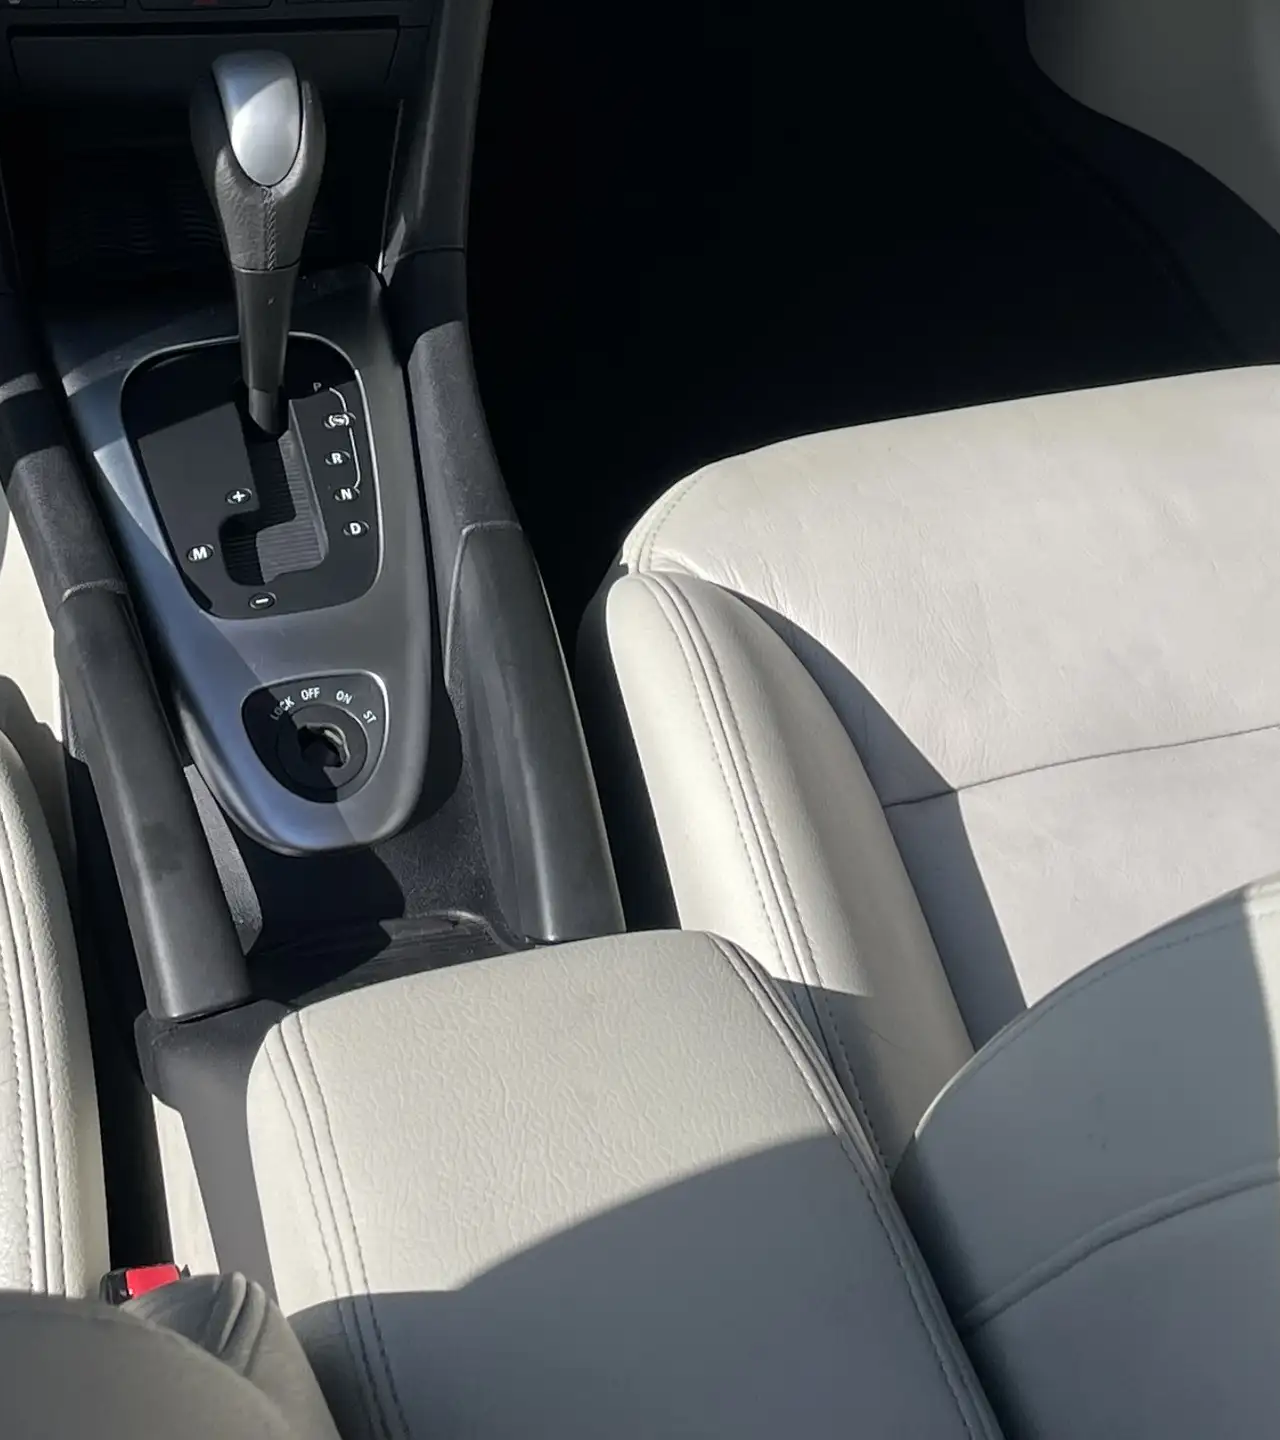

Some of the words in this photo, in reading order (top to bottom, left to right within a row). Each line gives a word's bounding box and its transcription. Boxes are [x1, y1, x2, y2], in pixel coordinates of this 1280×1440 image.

[312, 381, 323, 393] P
[331, 453, 343, 465] R
[340, 487, 353, 500] N
[349, 522, 361, 535] D
[191, 546, 208, 560] M
[300, 687, 320, 701] OFF
[335, 689, 353, 705] ON
[269, 695, 296, 721] LOCK
[362, 709, 378, 724] ST
